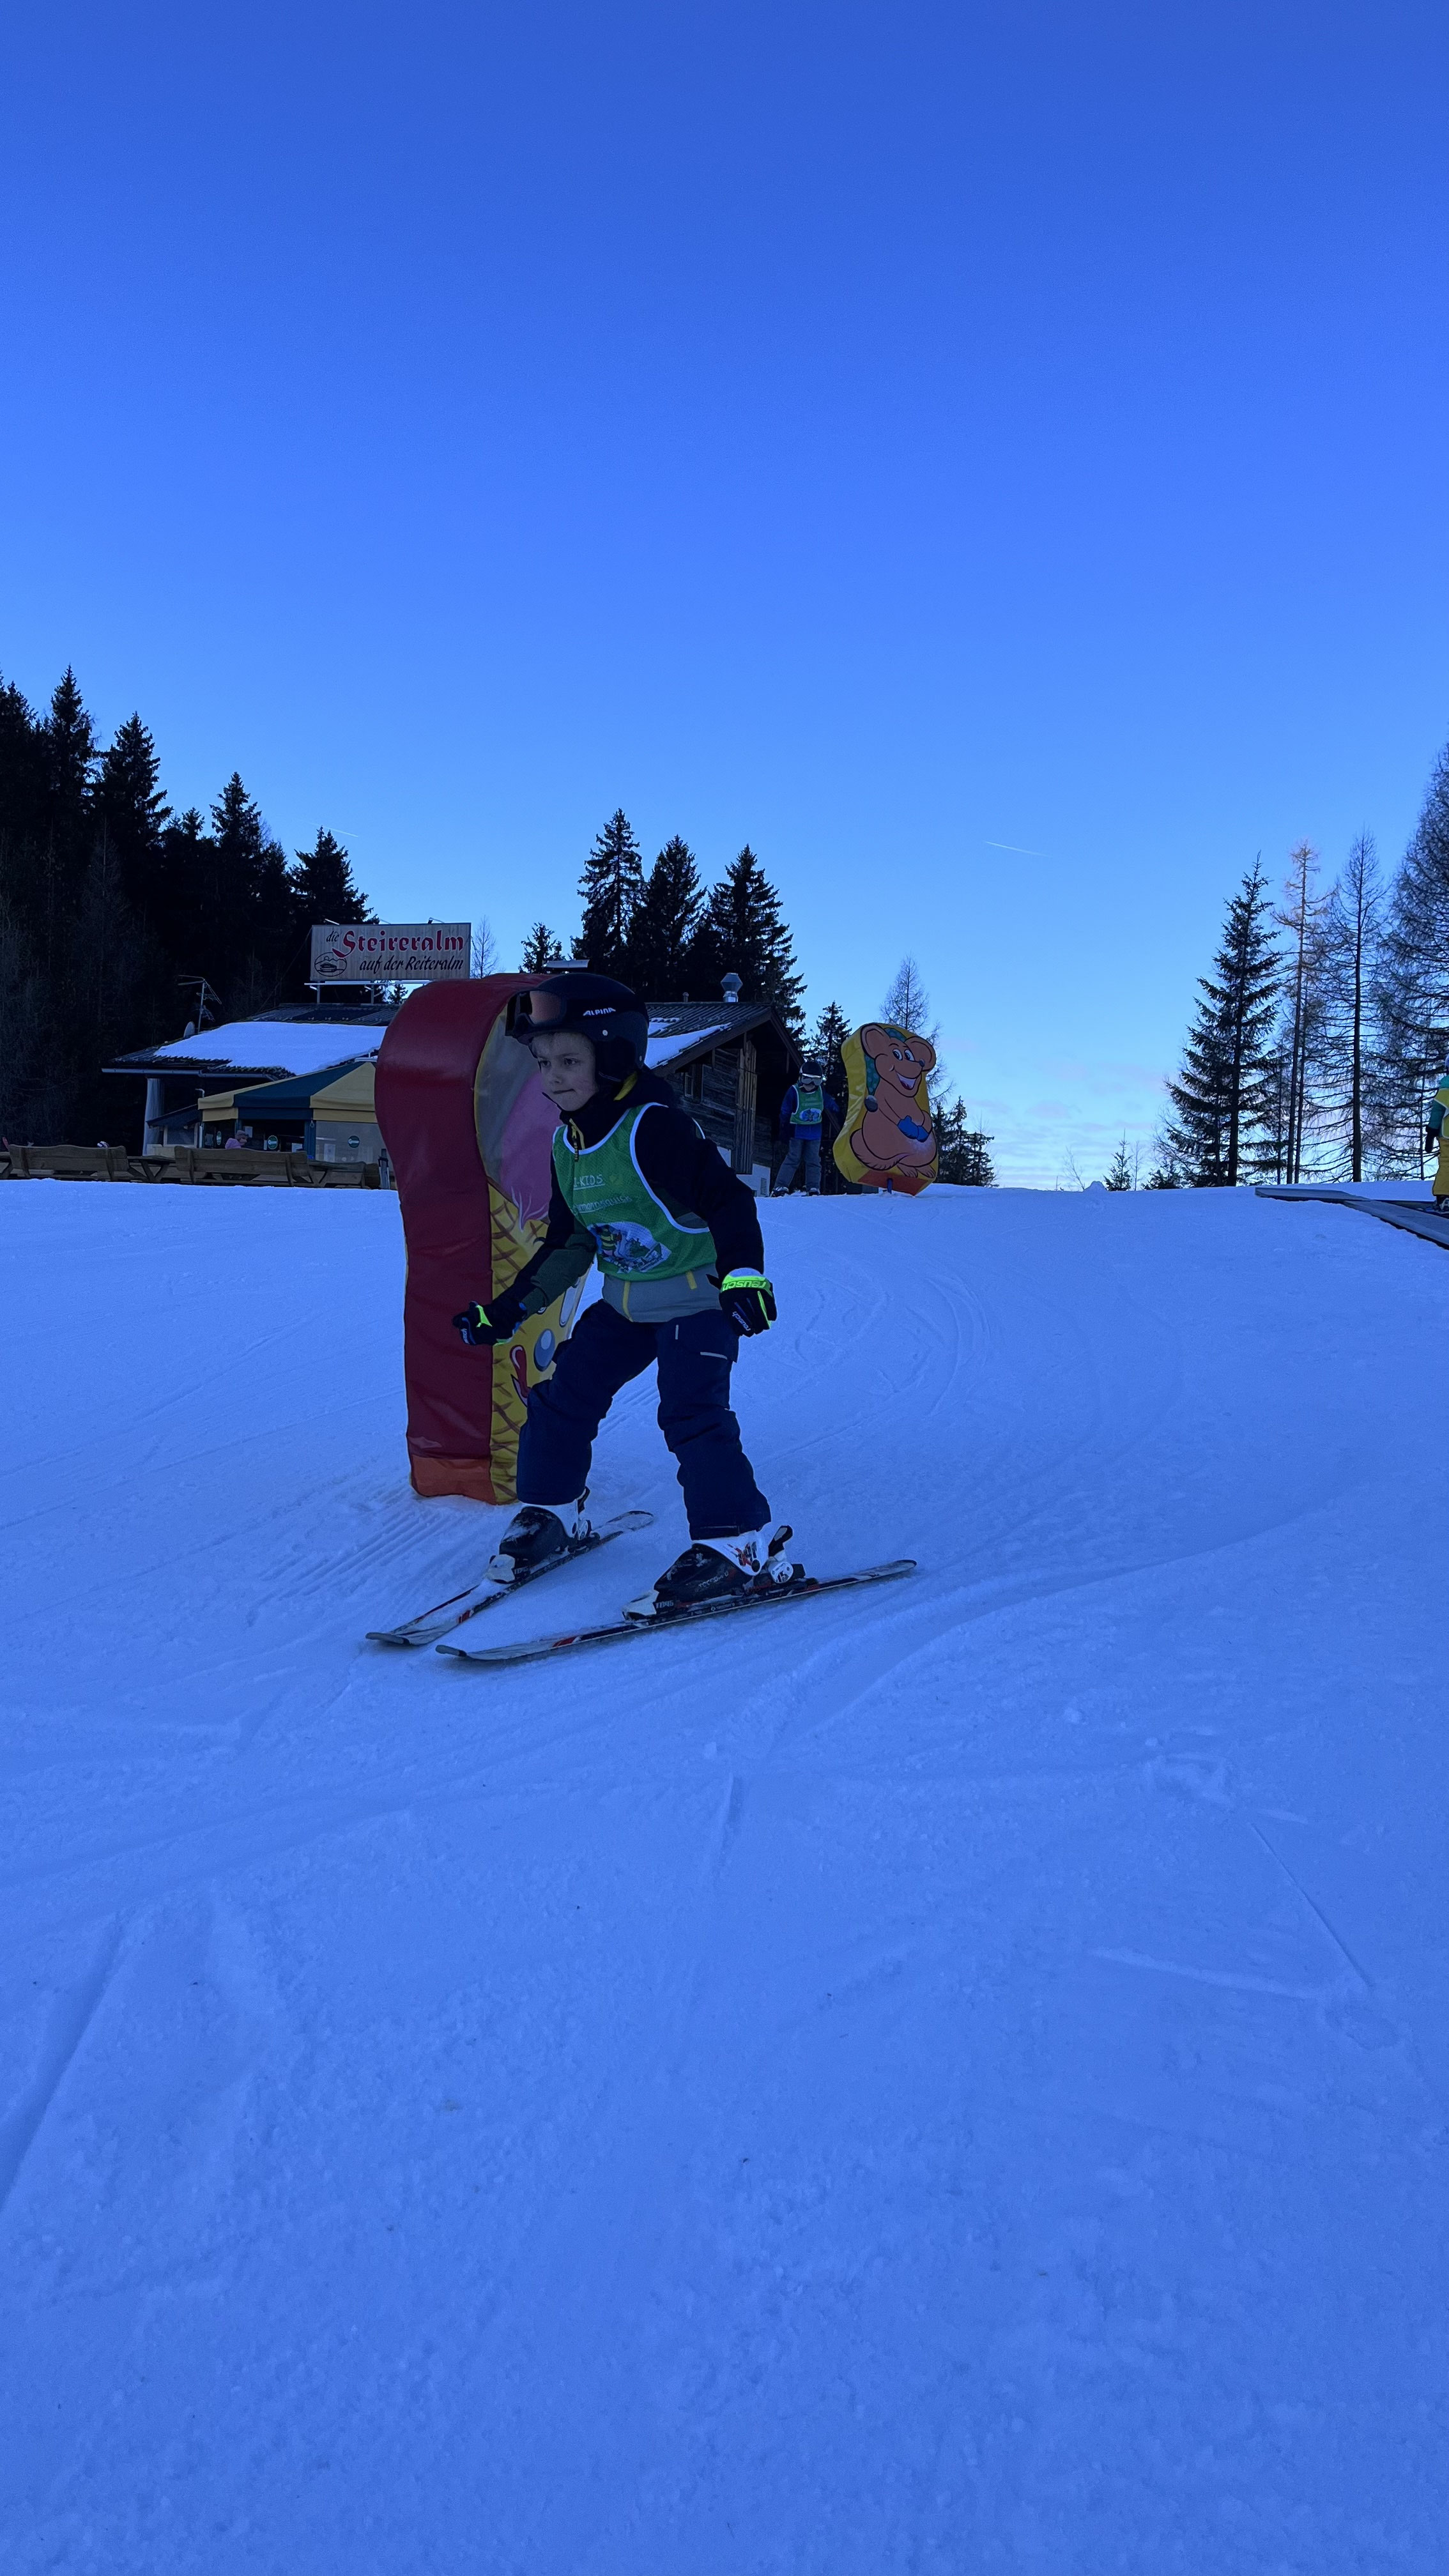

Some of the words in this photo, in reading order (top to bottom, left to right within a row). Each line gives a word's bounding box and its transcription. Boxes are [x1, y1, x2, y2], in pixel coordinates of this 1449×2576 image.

[326, 930, 340, 942] die
[332, 930, 464, 958] Steireralm
[359, 955, 382, 974] auf
[383, 955, 404, 970] der
[404, 955, 464, 970] Reiteralm
[582, 1007, 617, 1016] ALPINA
[732, 1311, 751, 1331] reusch
